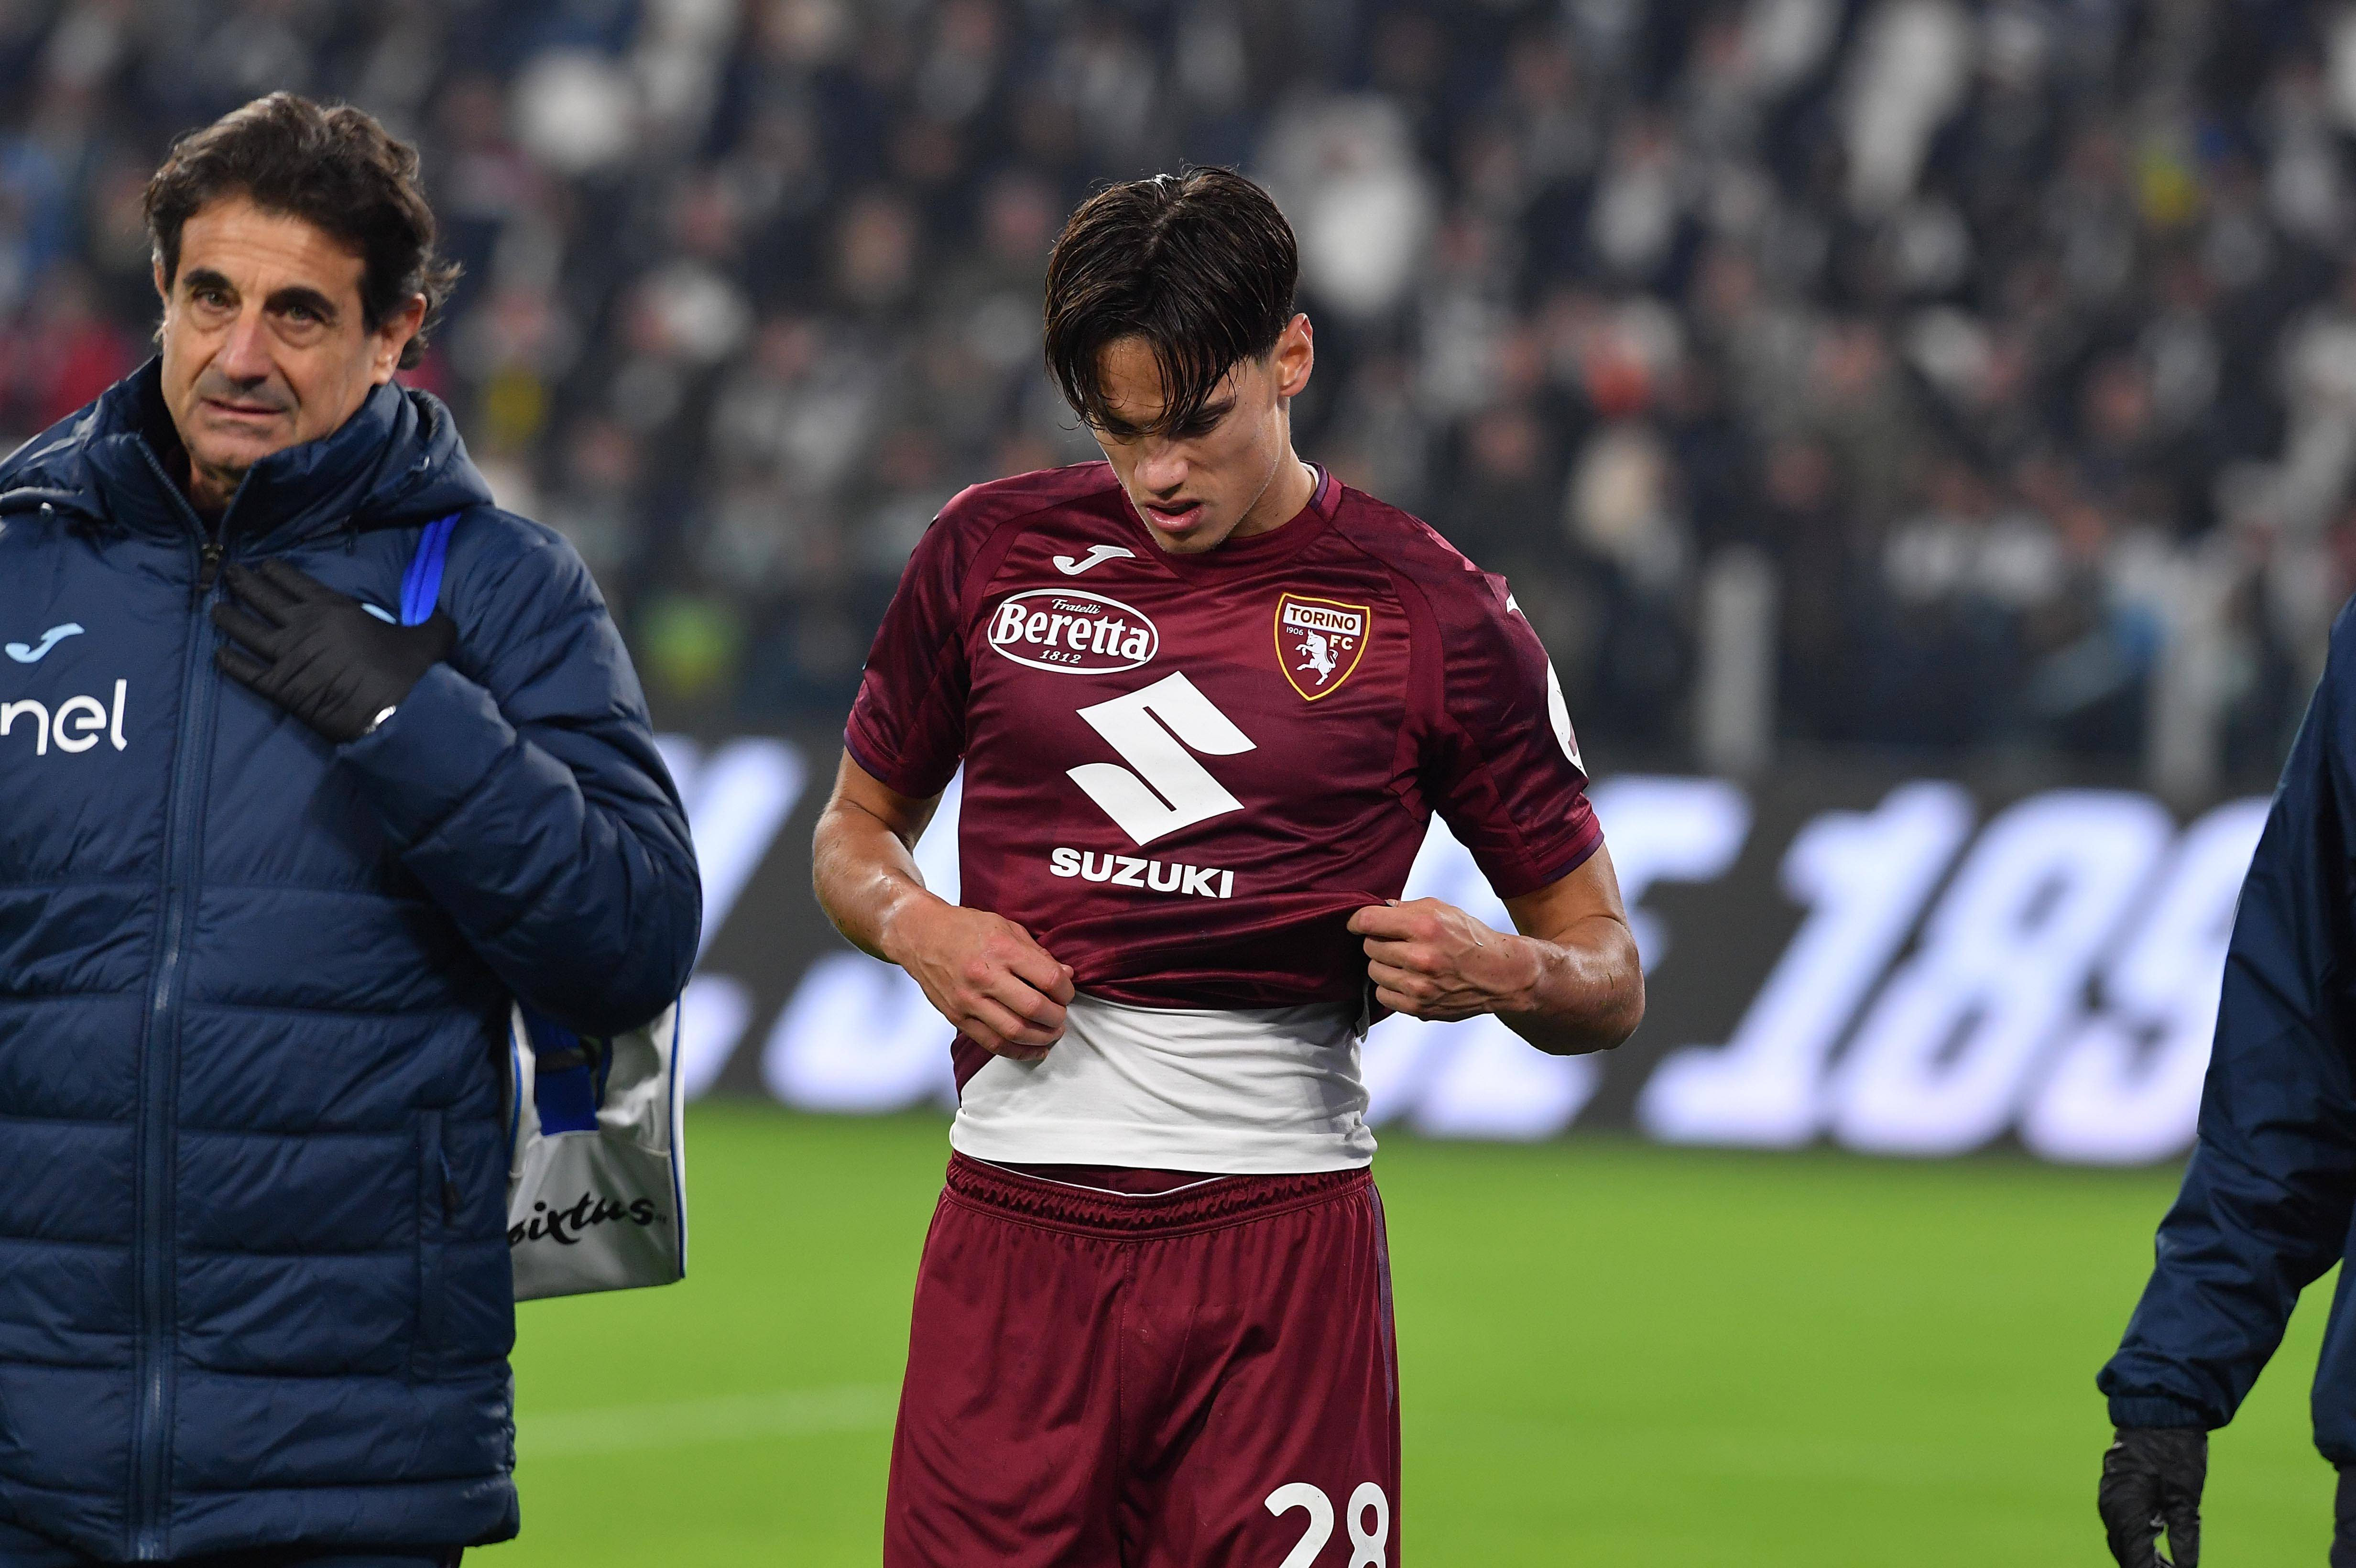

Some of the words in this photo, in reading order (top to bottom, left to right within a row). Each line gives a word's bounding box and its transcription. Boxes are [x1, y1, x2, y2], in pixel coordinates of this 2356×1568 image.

[1051, 598, 1102, 615] Fratelli
[1290, 607, 1356, 631] TORINO
[993, 603, 1150, 662] Beretta
[1286, 626, 1304, 635] 1906
[1329, 634, 1353, 650] FC
[1039, 650, 1081, 664] 1812
[1049, 848, 1234, 899] SUZUKI
[1264, 1482, 1389, 1568] 28
